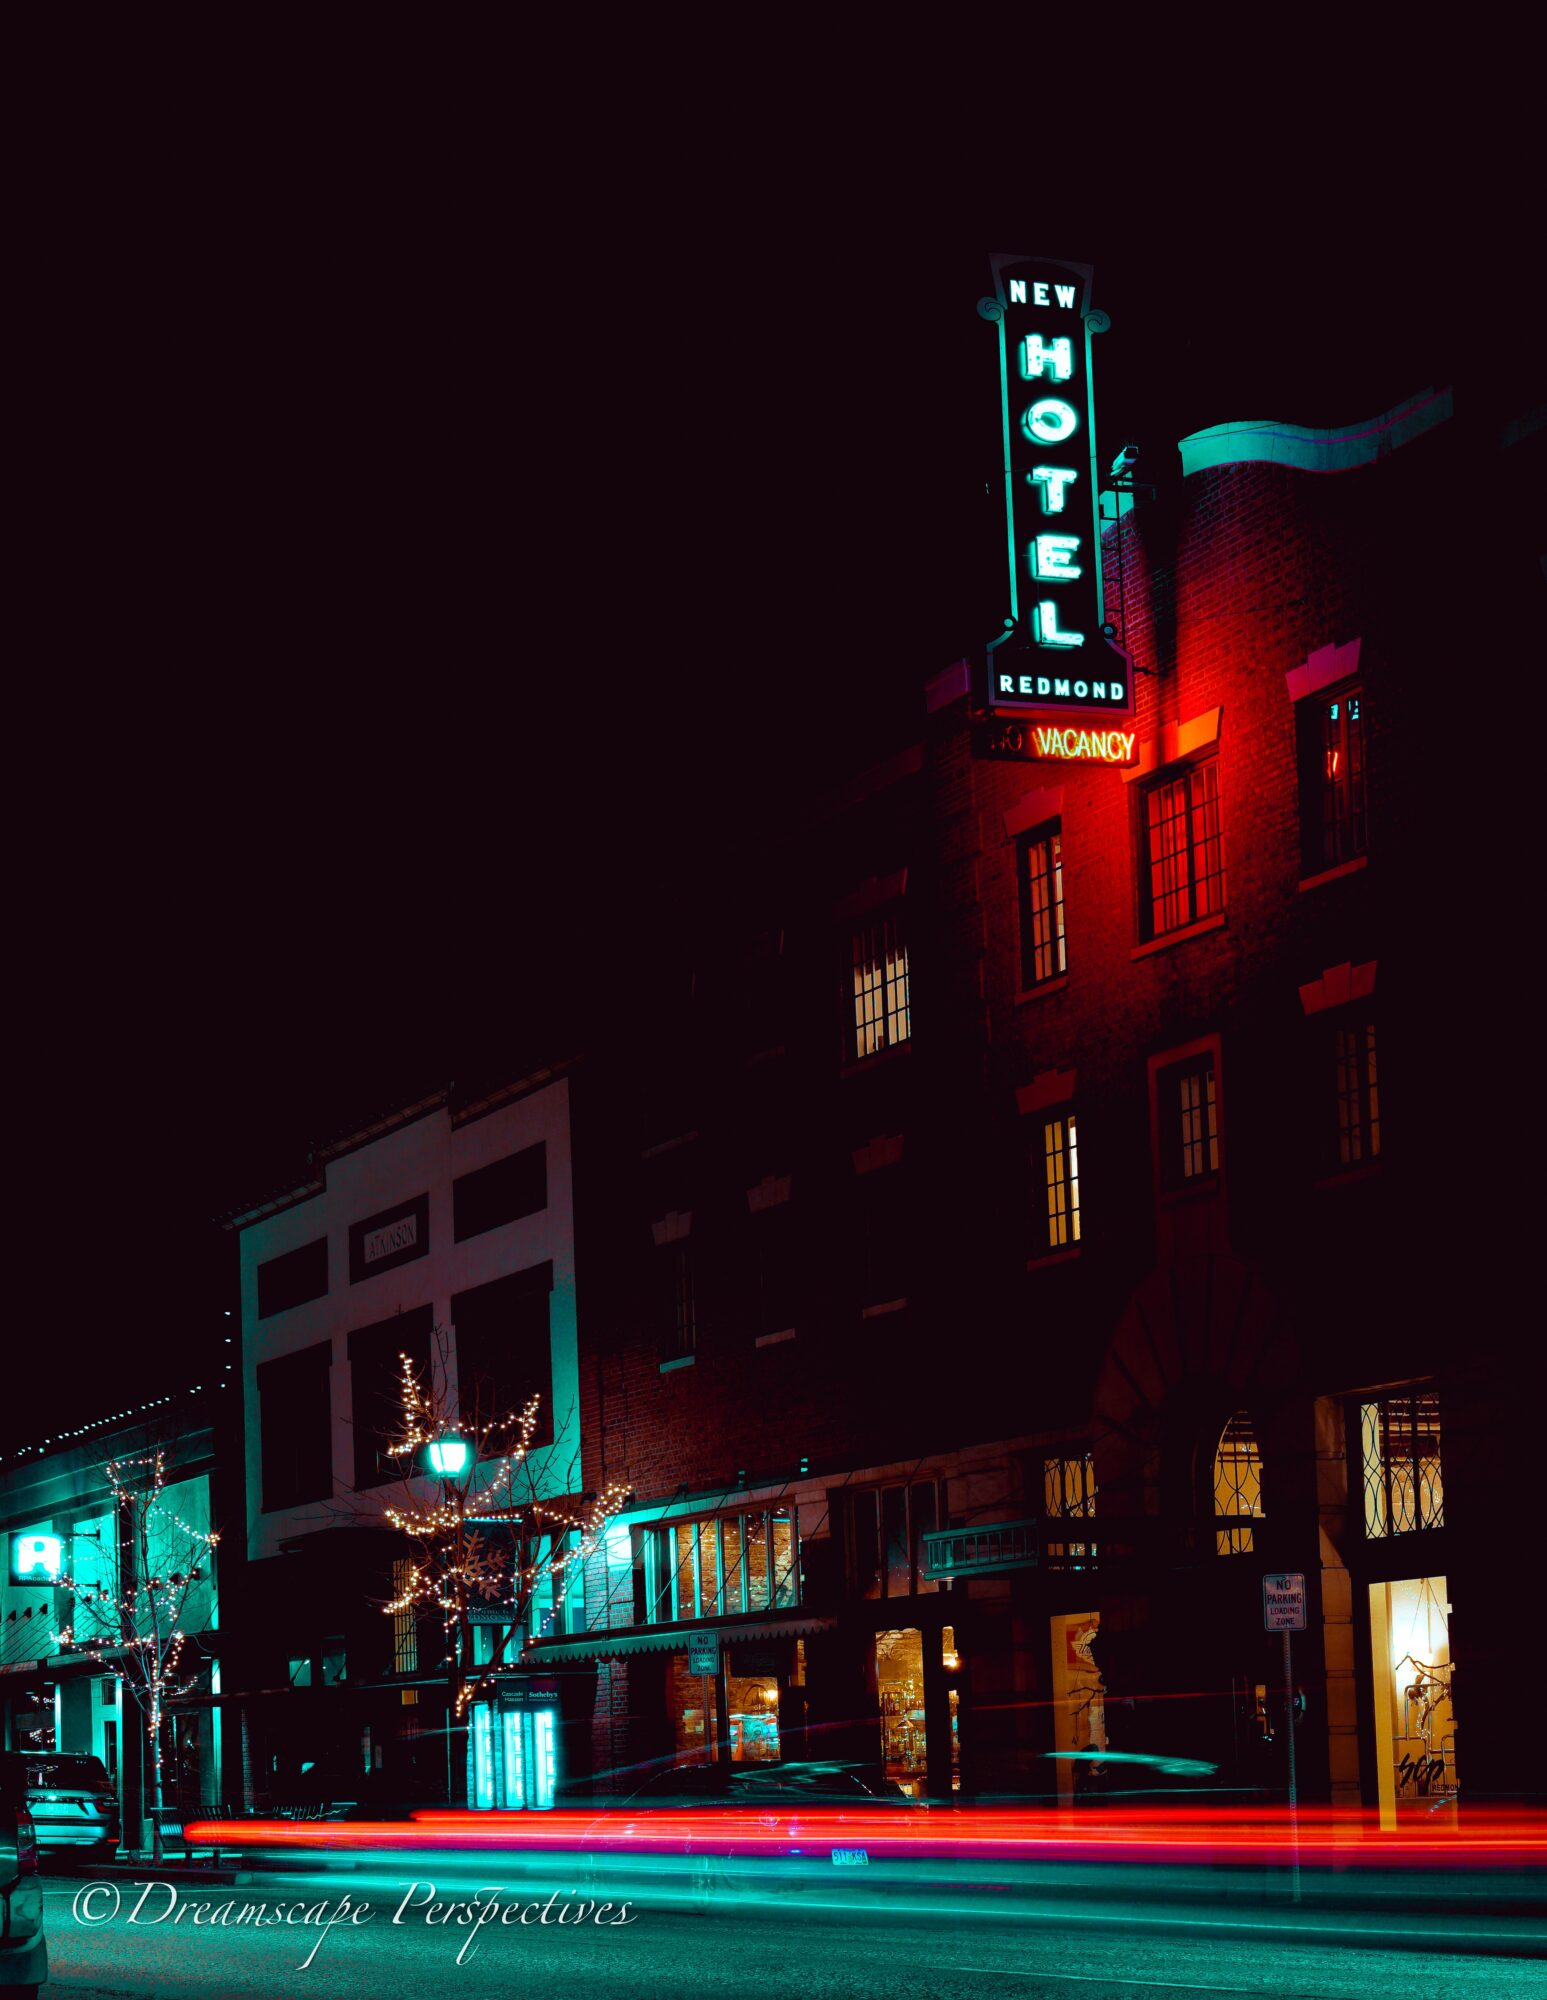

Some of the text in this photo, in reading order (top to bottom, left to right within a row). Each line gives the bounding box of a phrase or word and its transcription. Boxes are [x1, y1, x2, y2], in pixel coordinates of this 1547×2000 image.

[1010, 280, 1076, 309] NEW
[1021, 334, 1085, 649] HOTEL
[1000, 675, 1124, 700] REDMOND
[1033, 727, 1135, 762] VACANCY
[369, 1223, 415, 1258] ATKINSON
[1276, 1580, 1291, 1590] NO
[1267, 1593, 1302, 1604] PARKING
[1270, 1607, 1300, 1615] LOADING
[1275, 1617, 1295, 1625] ZONE
[697, 1636, 709, 1645] NO
[528, 1691, 558, 1699] Sotheby's
